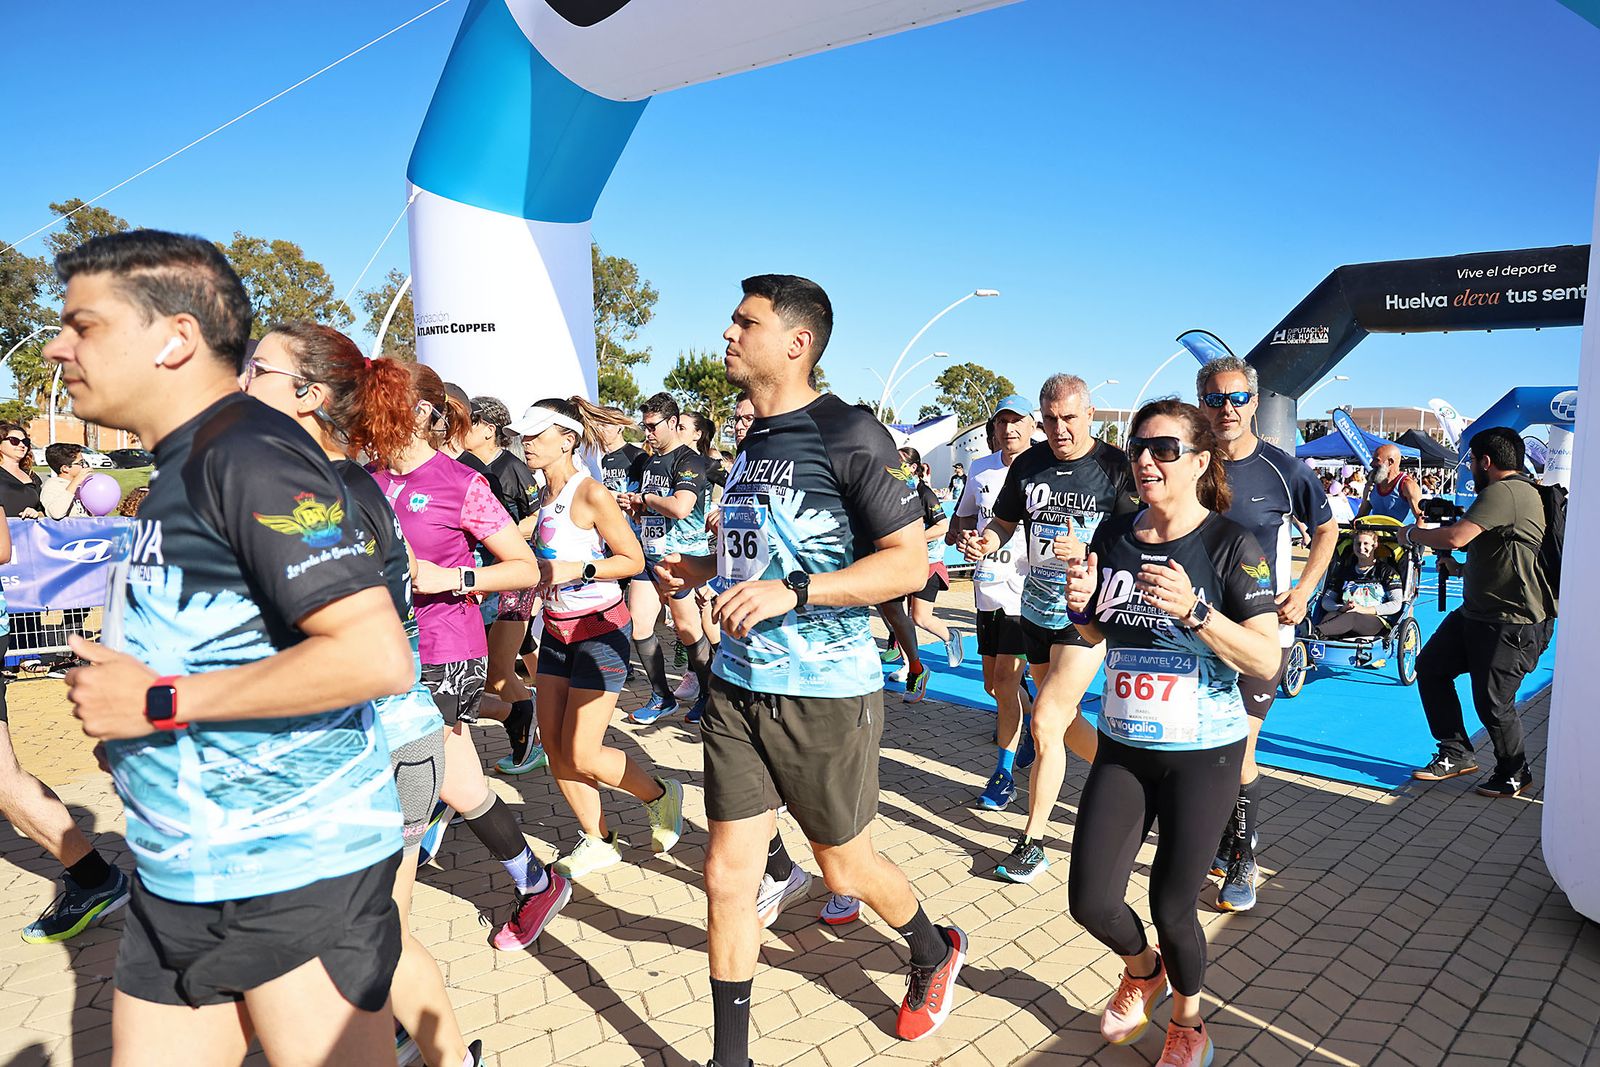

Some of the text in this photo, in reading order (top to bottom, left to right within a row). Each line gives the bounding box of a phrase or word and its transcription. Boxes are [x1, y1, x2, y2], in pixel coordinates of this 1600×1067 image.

[1457, 263, 1557, 279] Vive el deporte
[1385, 292, 1448, 310] Huelva
[1453, 288, 1500, 307] eleva
[1506, 289, 1537, 303] tus
[417, 323, 496, 337] ATLANTIC COPPER
[739, 459, 795, 487] HUELVA
[649, 475, 670, 488] HUELVA
[1048, 491, 1097, 511] HUELVA
[1126, 603, 1147, 613] PUERTA
[1138, 656, 1170, 665] AVATEL
[1115, 671, 1179, 702] 667
[1115, 720, 1157, 734] Wayalia
